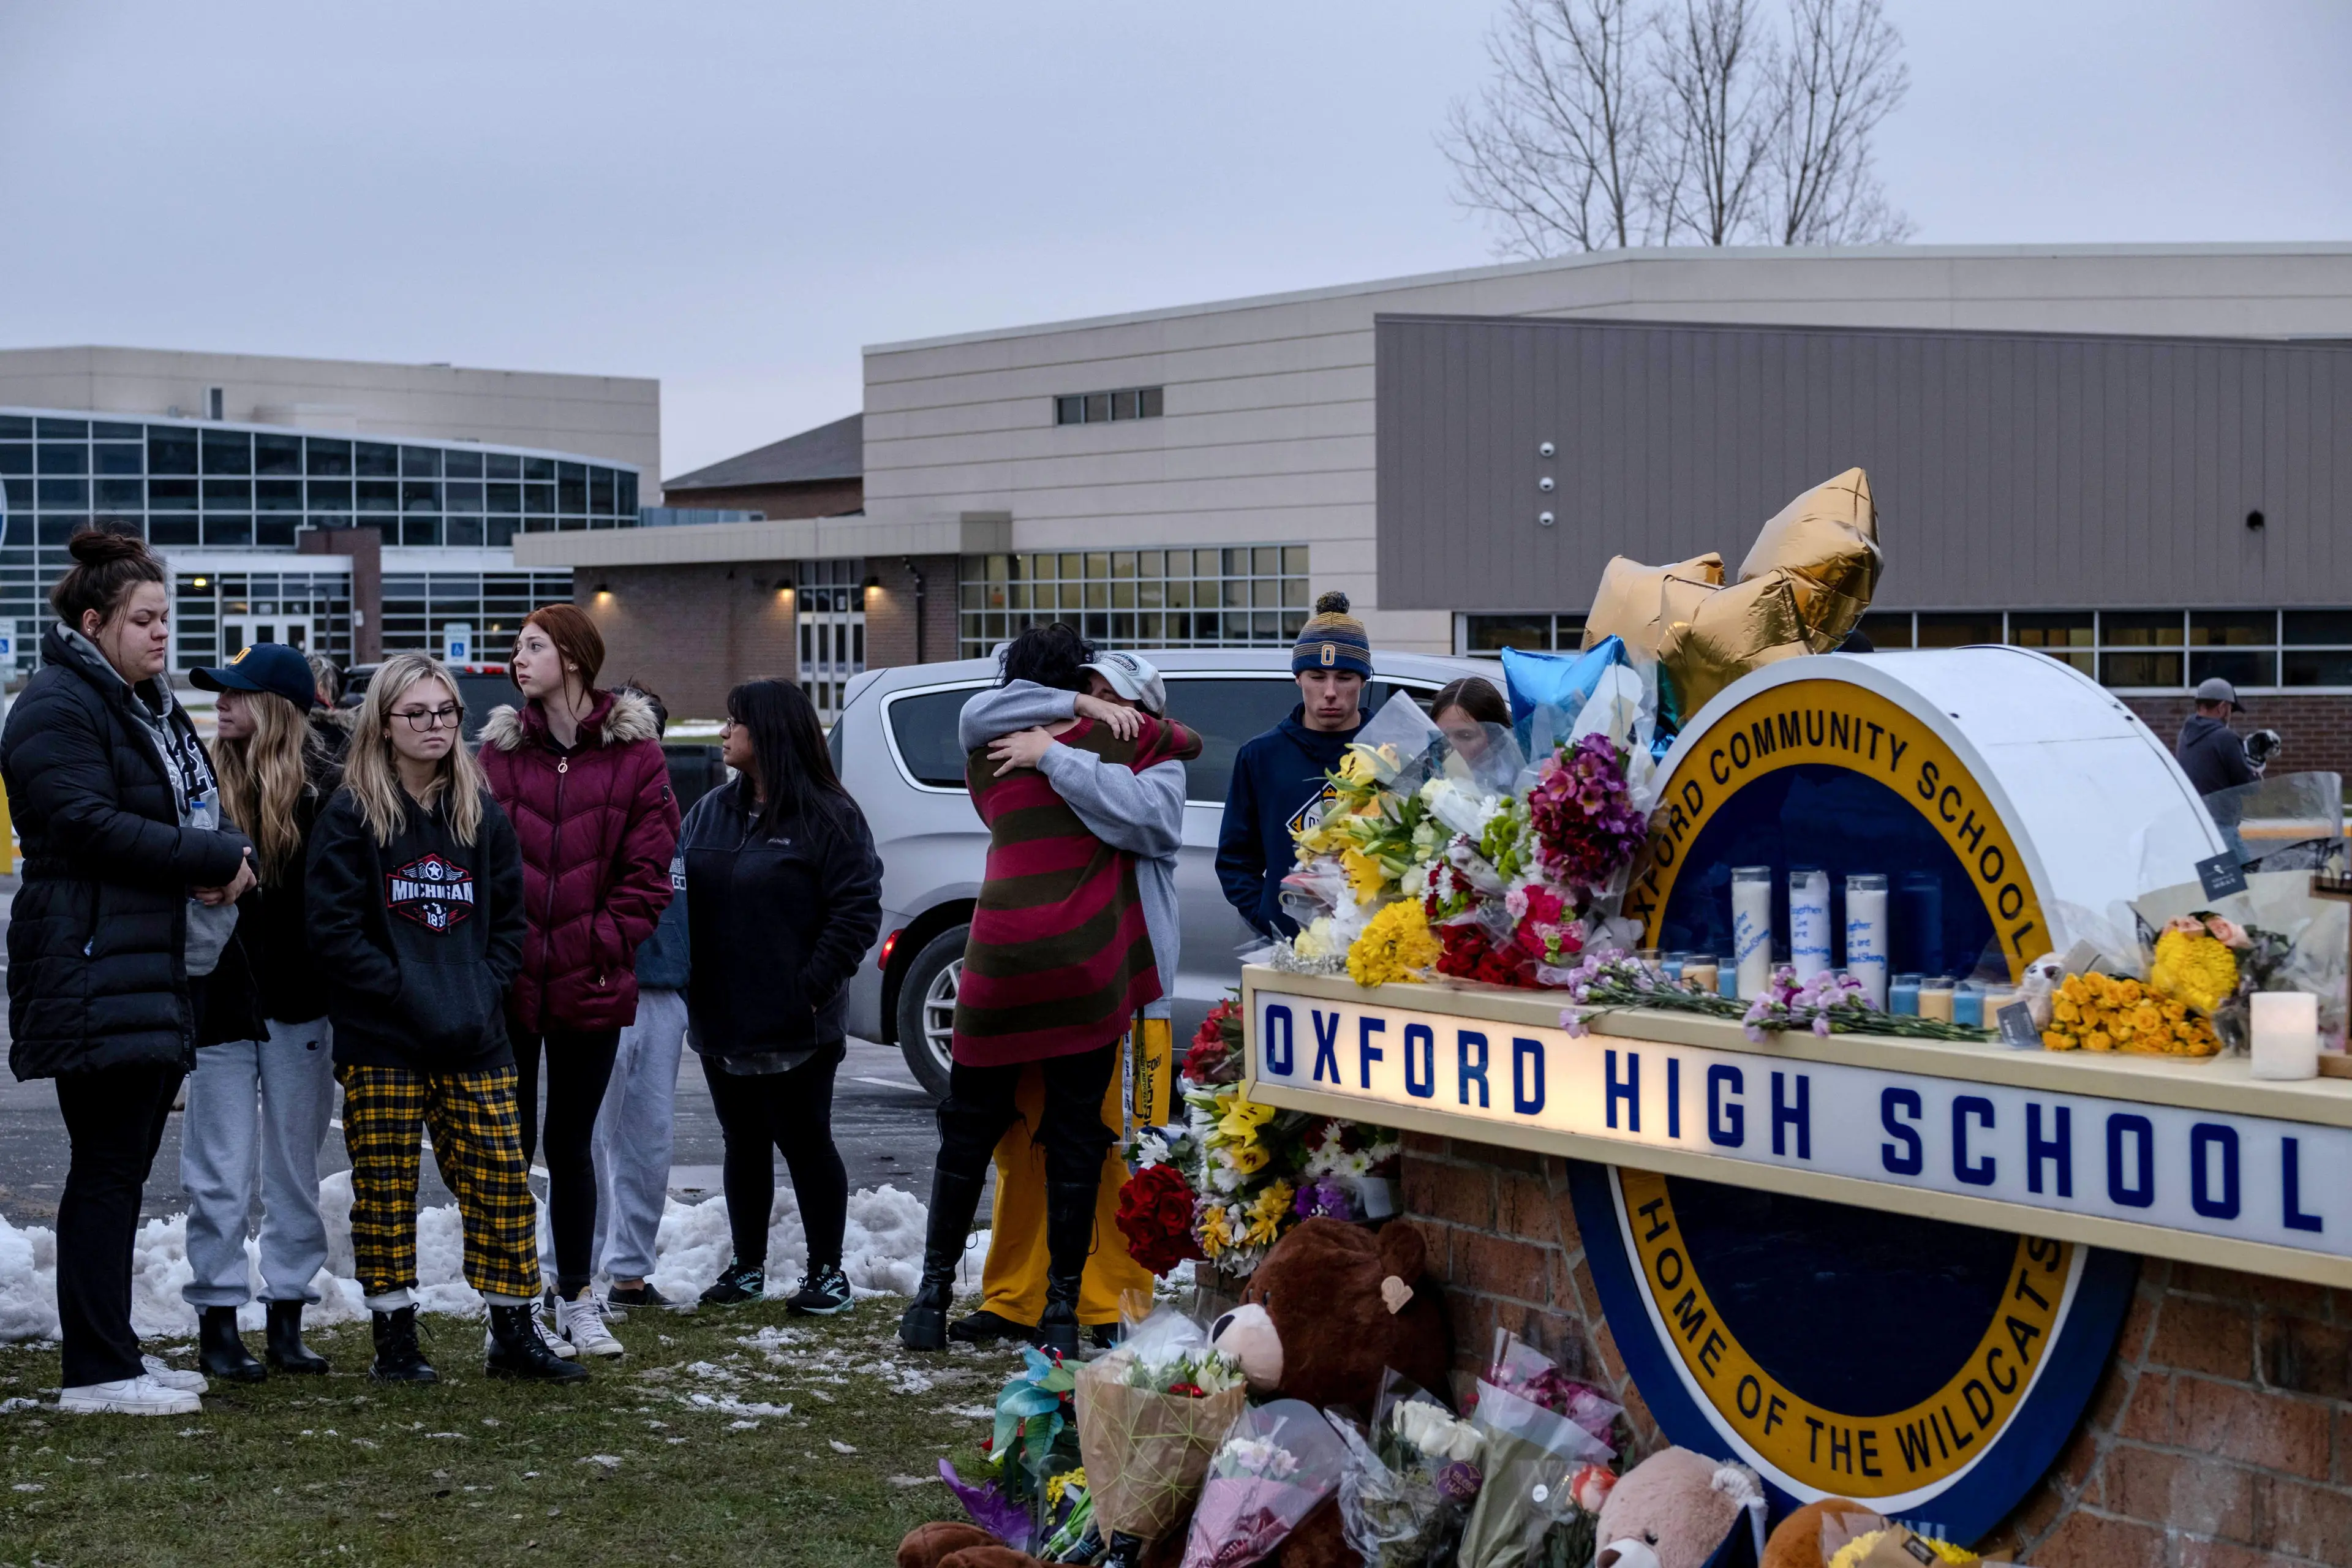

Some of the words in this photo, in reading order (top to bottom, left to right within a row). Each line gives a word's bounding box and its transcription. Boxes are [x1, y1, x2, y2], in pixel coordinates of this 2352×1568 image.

[392, 879, 474, 905] MICHIGAN
[1633, 780, 1703, 927] XFORD
[1710, 709, 1908, 785] COMMUNITY
[1917, 761, 2035, 962] SCHOOL
[1857, 938, 1871, 947] are
[1265, 1004, 1545, 1115] OXFORD
[1605, 1049, 1811, 1159] HIGH
[1881, 1087, 2323, 1233] SCHOOL
[1638, 1197, 1727, 1378] HOME
[1737, 1374, 1787, 1436] OF
[1805, 1415, 1882, 1477] THE
[1895, 1236, 2062, 1472] WILDCATS
